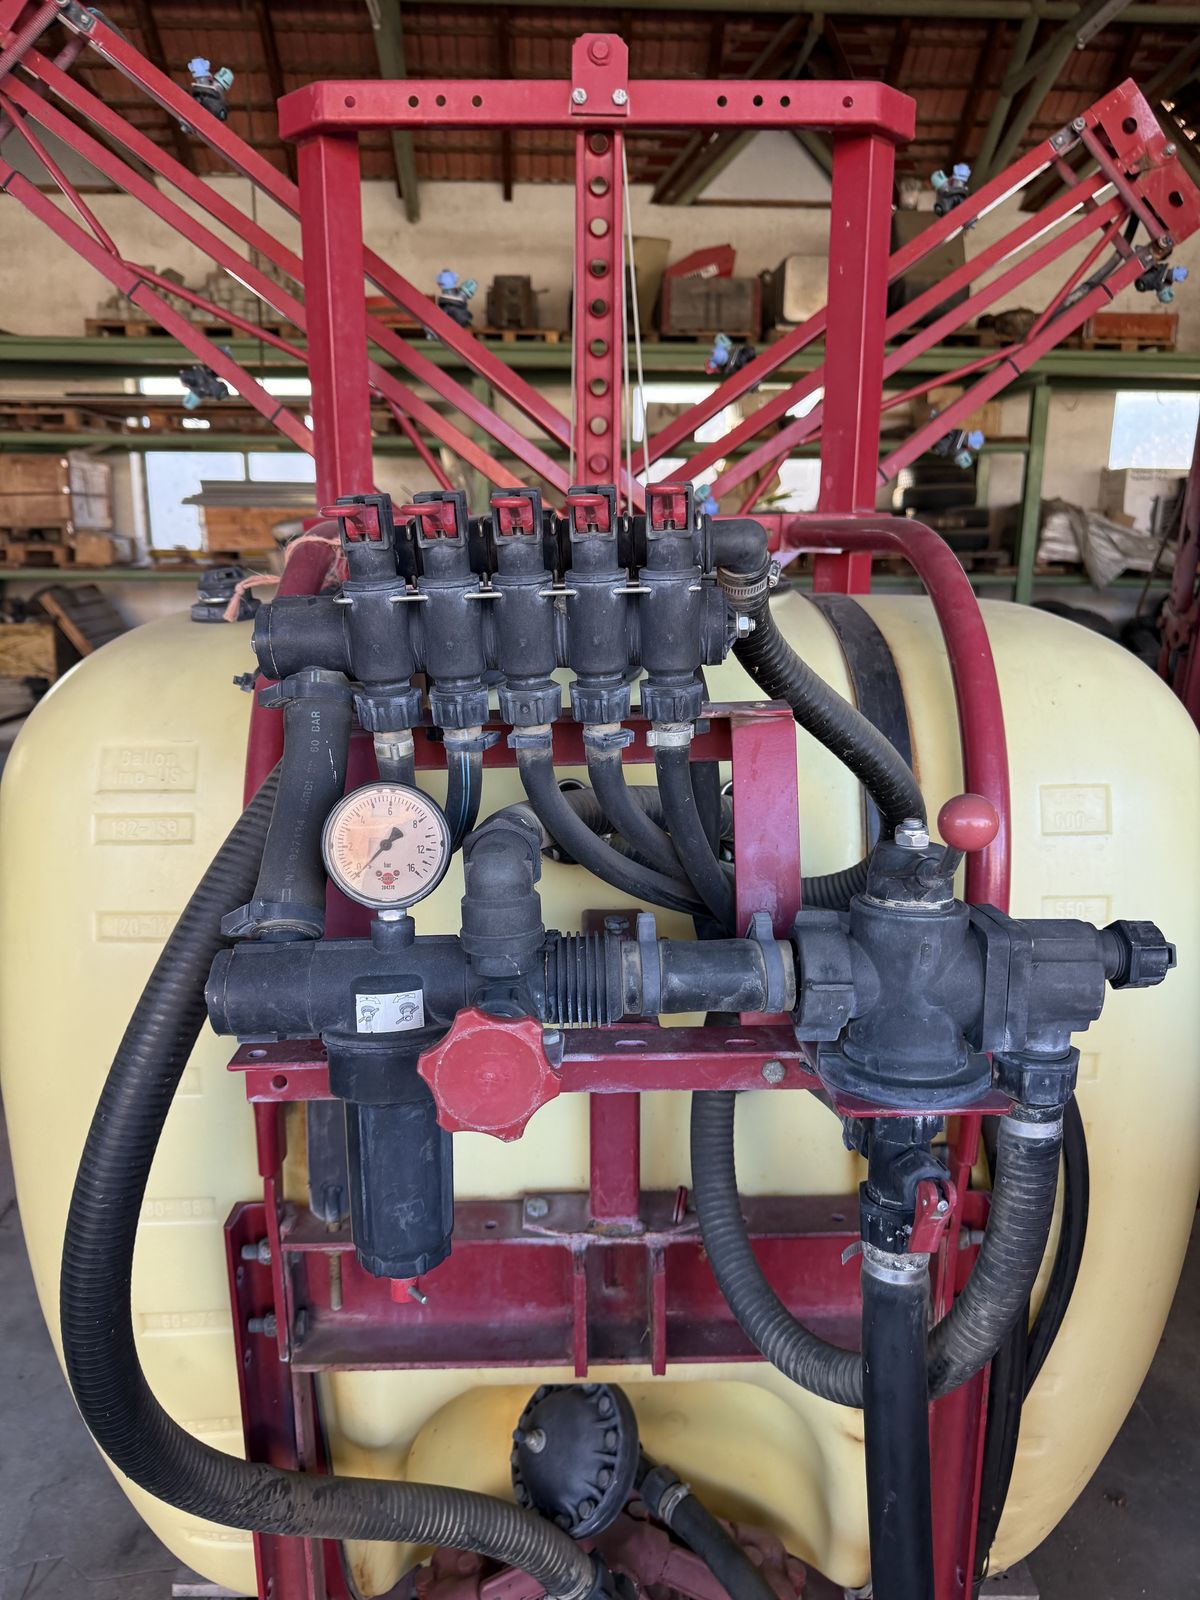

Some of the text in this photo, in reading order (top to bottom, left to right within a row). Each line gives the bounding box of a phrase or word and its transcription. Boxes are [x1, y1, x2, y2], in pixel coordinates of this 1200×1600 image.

[311, 711, 321, 732] BAR
[417, 845, 425, 854] 12
[407, 863, 415, 873] 16
